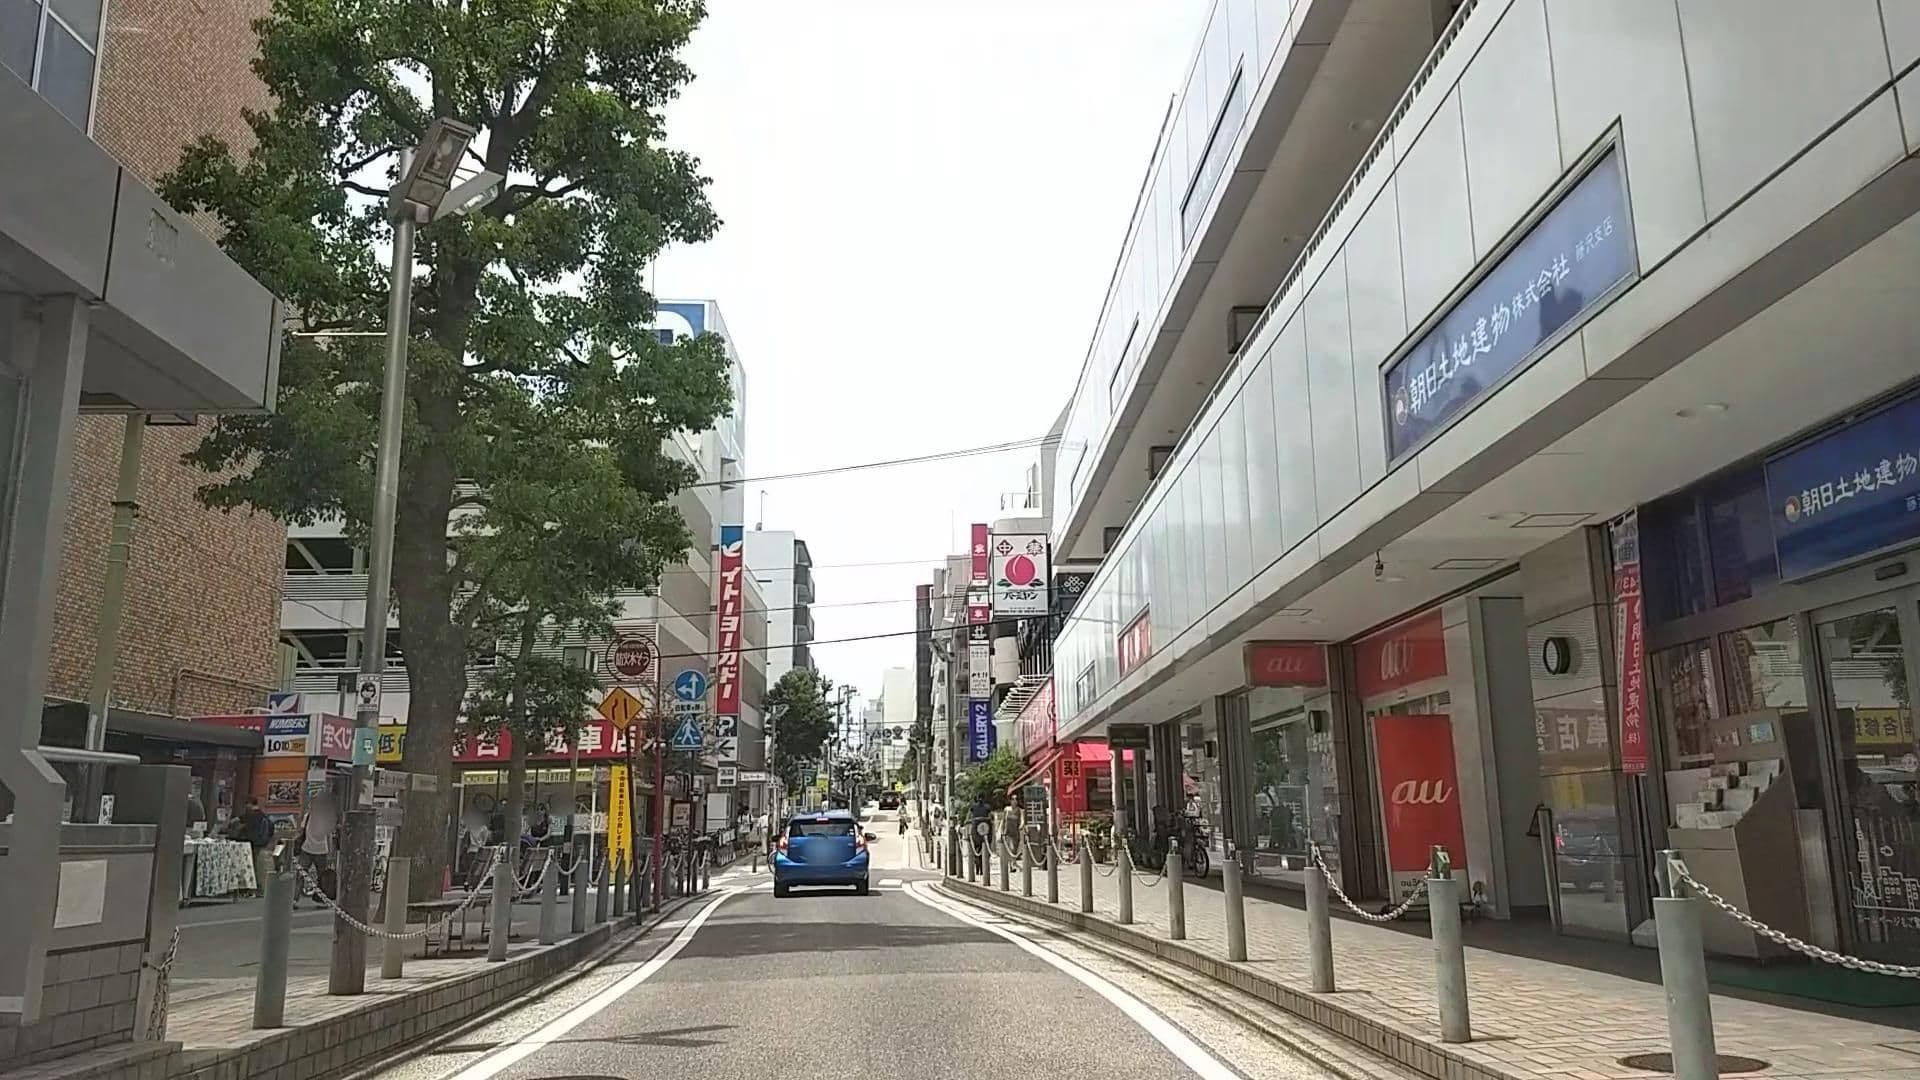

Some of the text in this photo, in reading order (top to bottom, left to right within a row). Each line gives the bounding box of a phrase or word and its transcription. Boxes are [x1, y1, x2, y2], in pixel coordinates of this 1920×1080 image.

[1409, 255, 1571, 413] 朝日土地建物株式会社
[1801, 450, 1920, 516] 朝日土地建物
[718, 565, 742, 699] イトーヨーカドー
[1267, 654, 1307, 674] au
[1380, 634, 1414, 680] au
[268, 718, 308, 729] NUMBERS
[322, 722, 352, 751] 宝くじ
[1390, 779, 1454, 805] au
